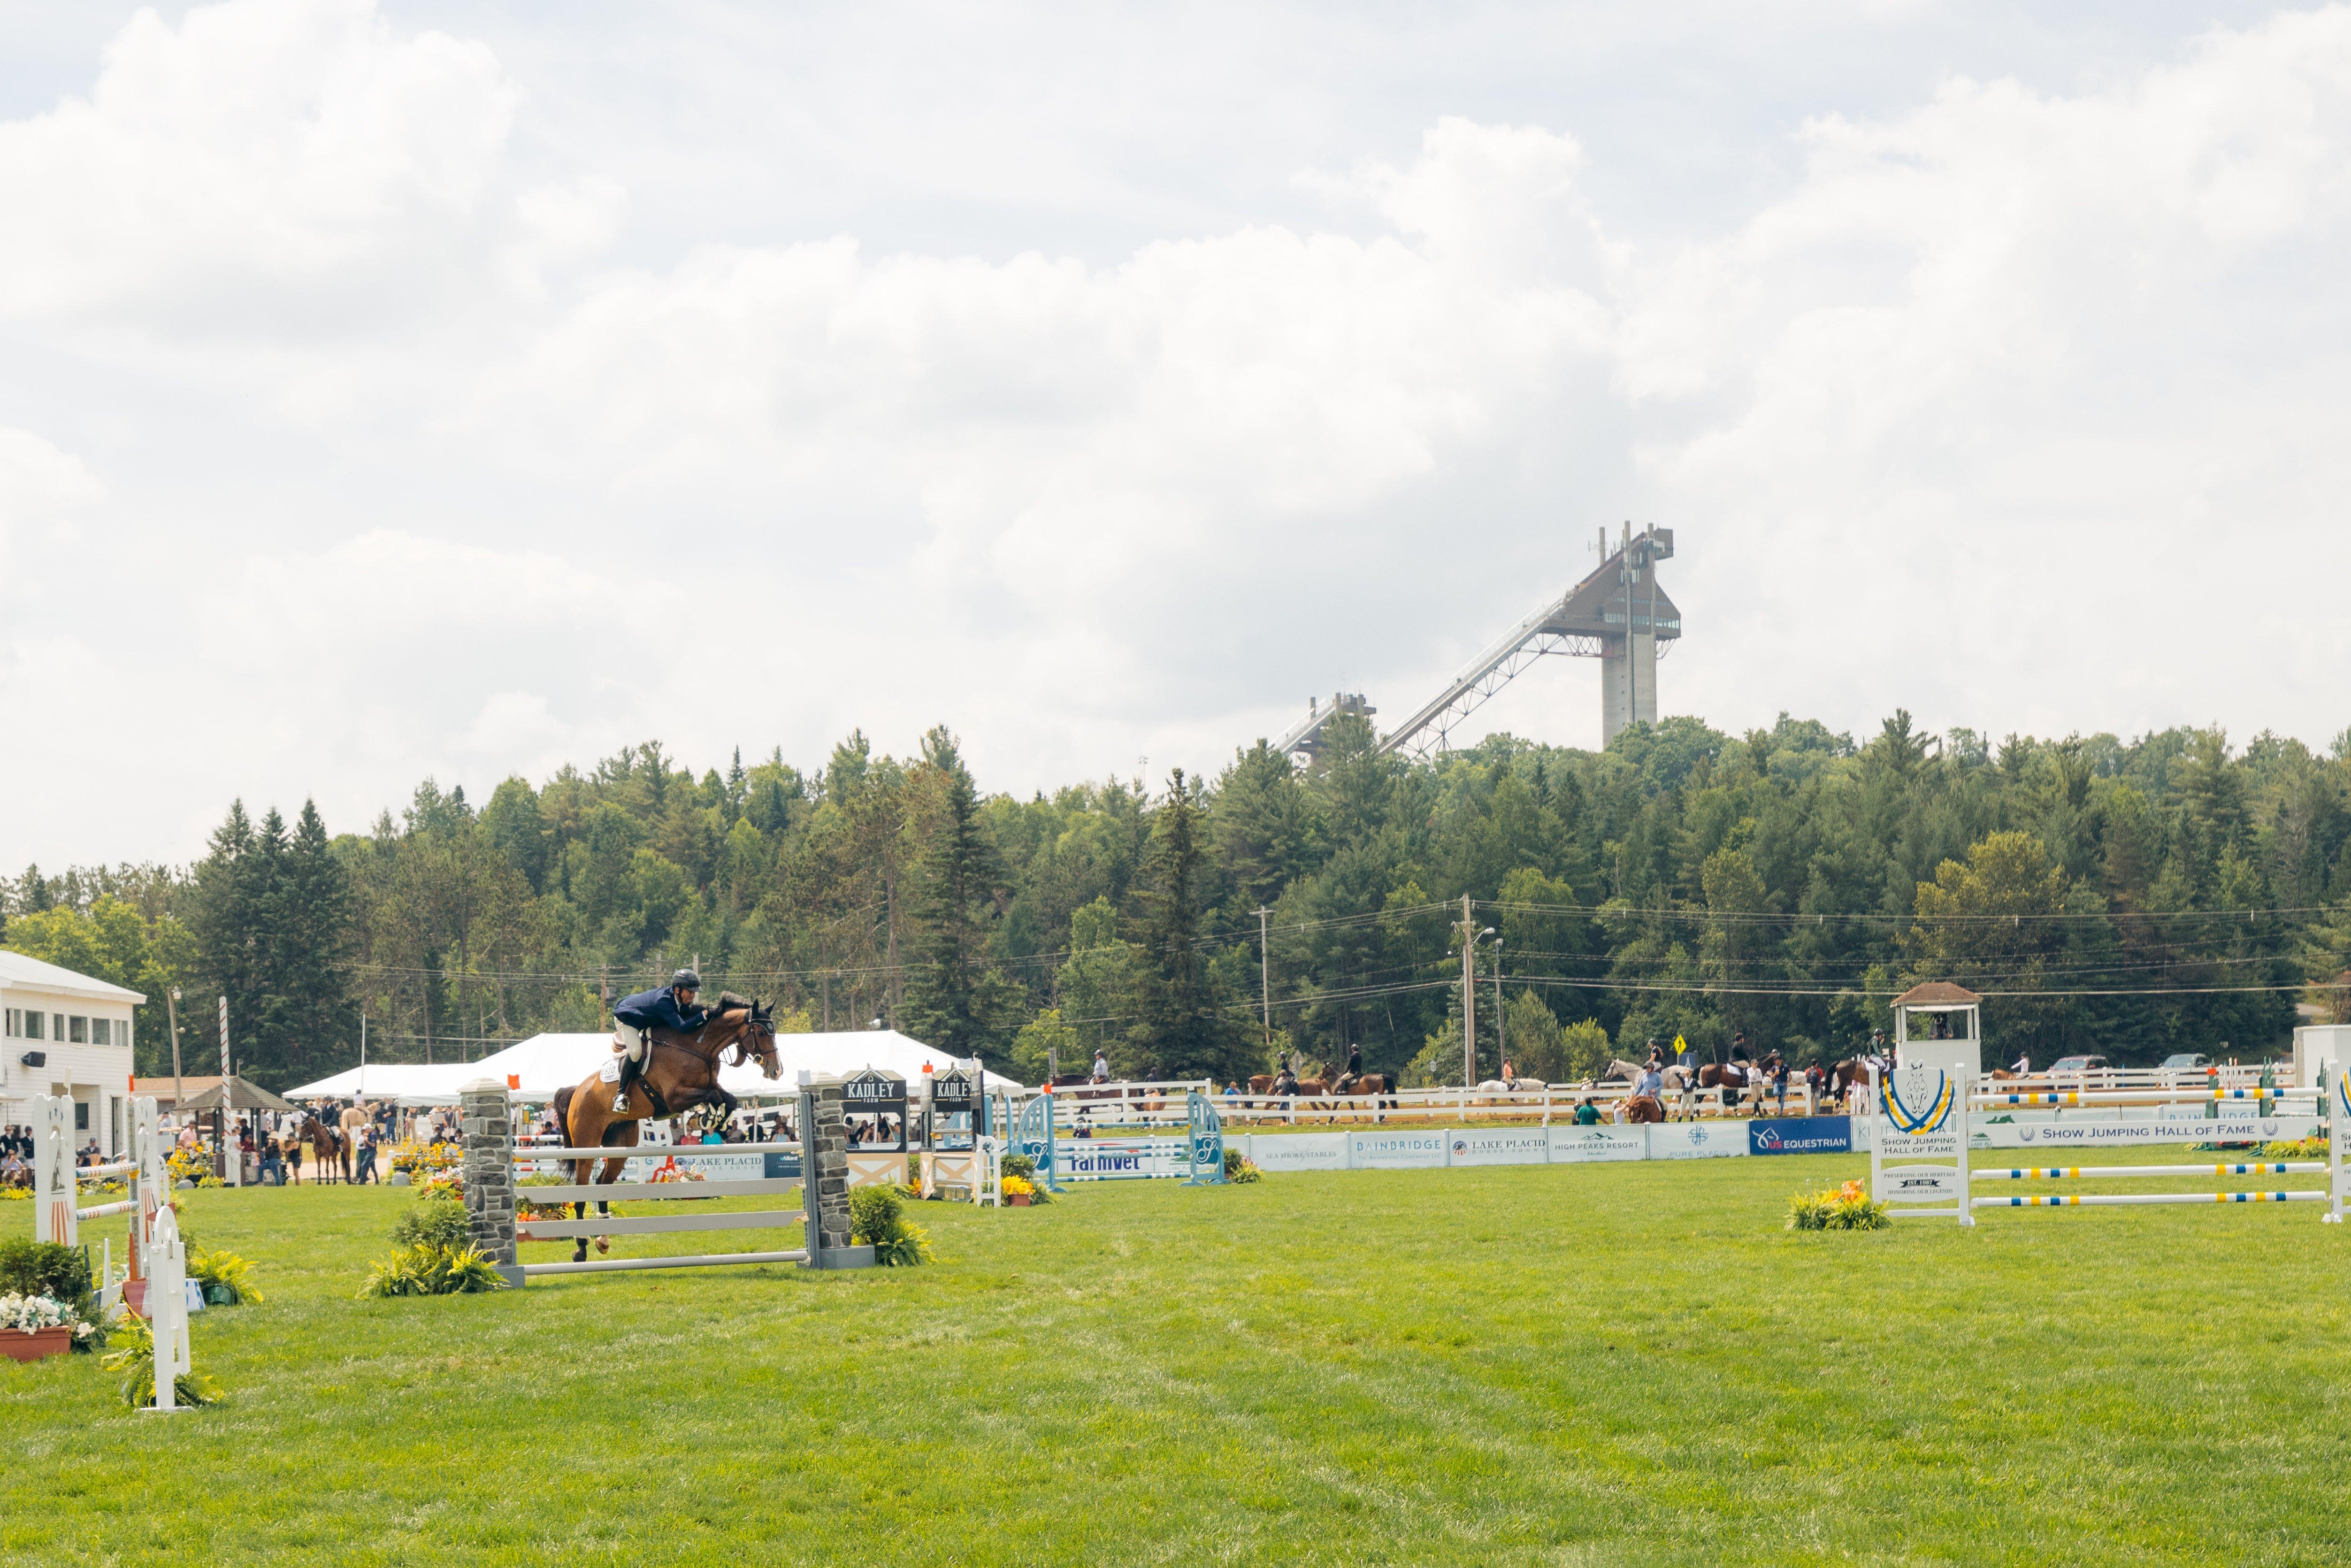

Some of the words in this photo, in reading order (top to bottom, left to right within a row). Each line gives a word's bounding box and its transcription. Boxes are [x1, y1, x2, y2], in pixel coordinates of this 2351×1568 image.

[848, 1083, 894, 1098] KADLEY
[1357, 1140, 1441, 1150] BAINBRIDGE
[1506, 1139, 1546, 1148] PLACID
[1784, 1138, 1846, 1149] EQUESTRIAN
